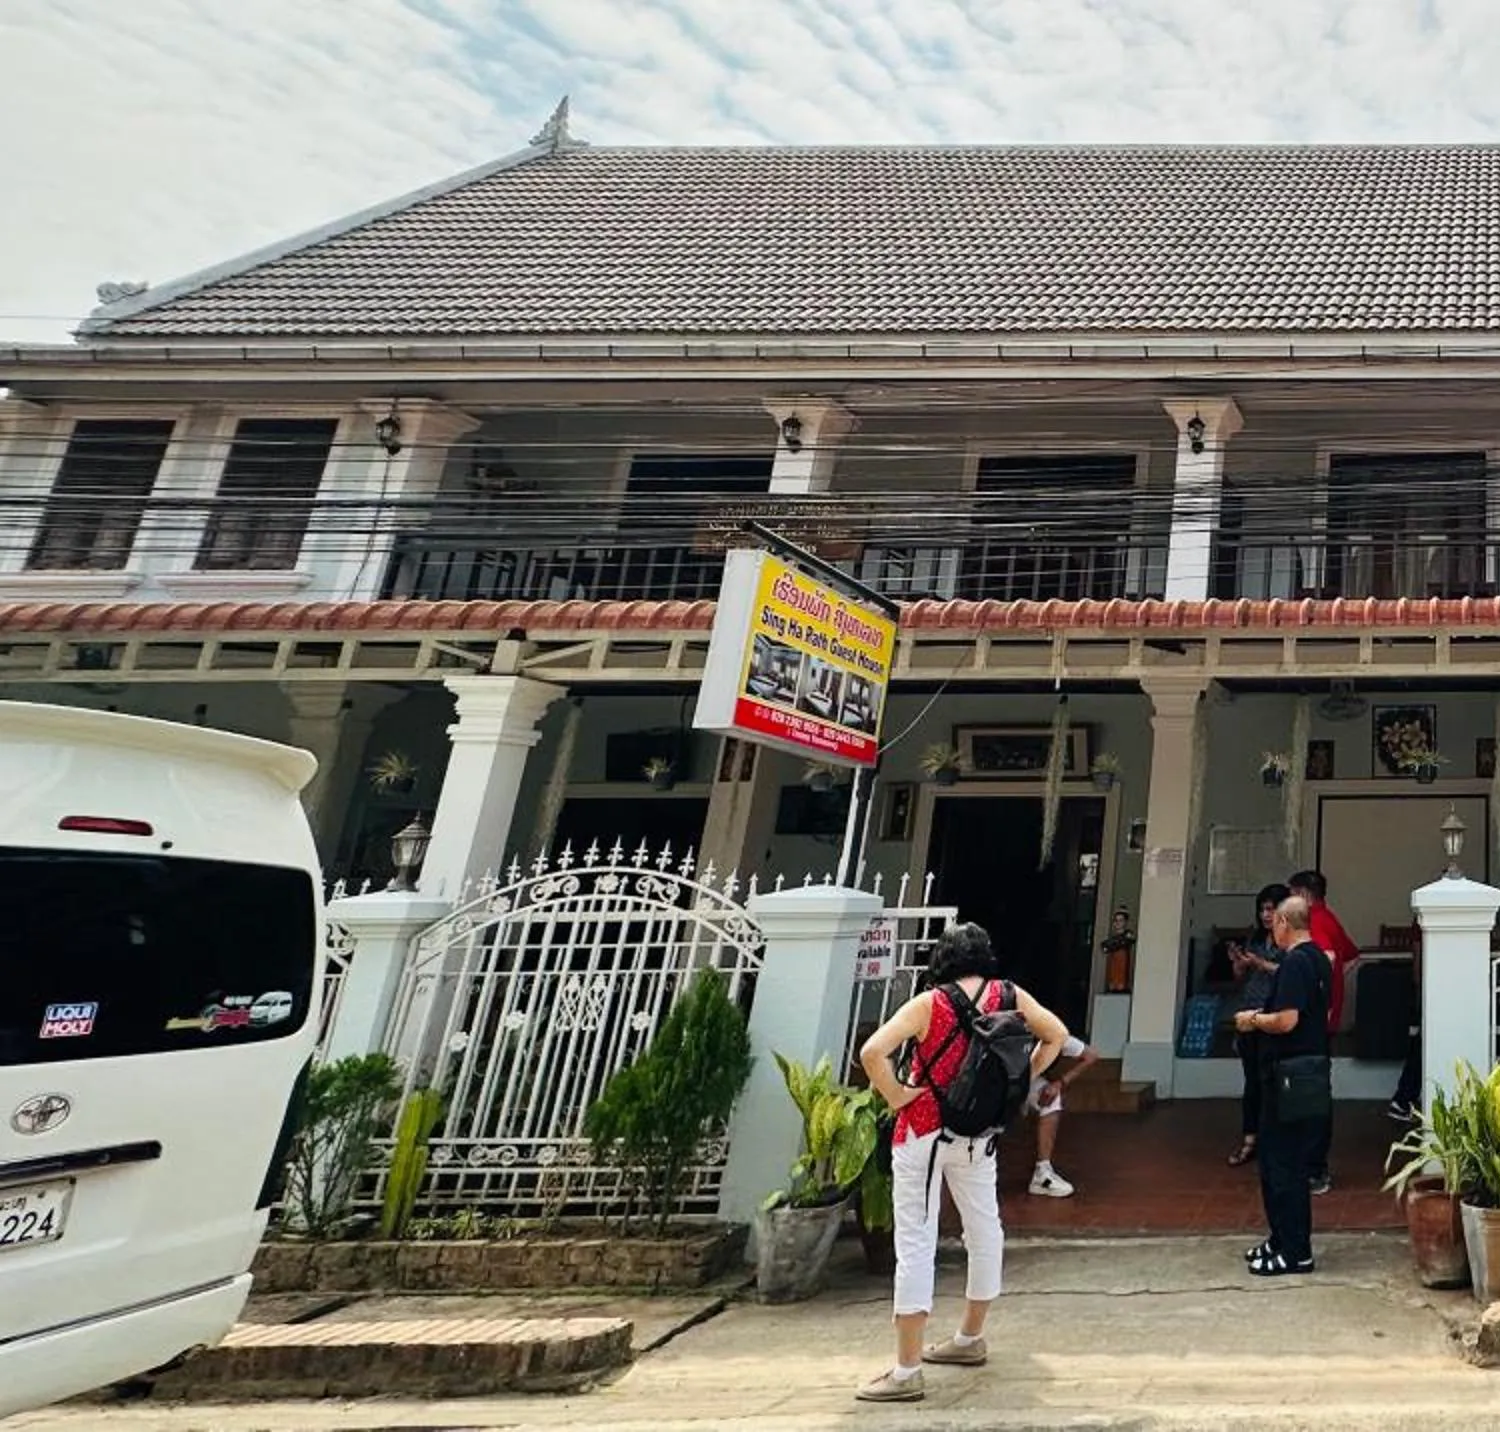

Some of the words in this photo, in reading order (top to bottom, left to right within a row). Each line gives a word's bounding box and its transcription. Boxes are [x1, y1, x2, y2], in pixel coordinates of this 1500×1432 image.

[761, 605, 785, 636] Sing
[830, 637, 856, 665] Guest
[858, 650, 884, 675] House
[48, 1004, 91, 1020] LIQUI
[43, 1020, 90, 1036] MOLY
[0, 1208, 54, 1245] 224
